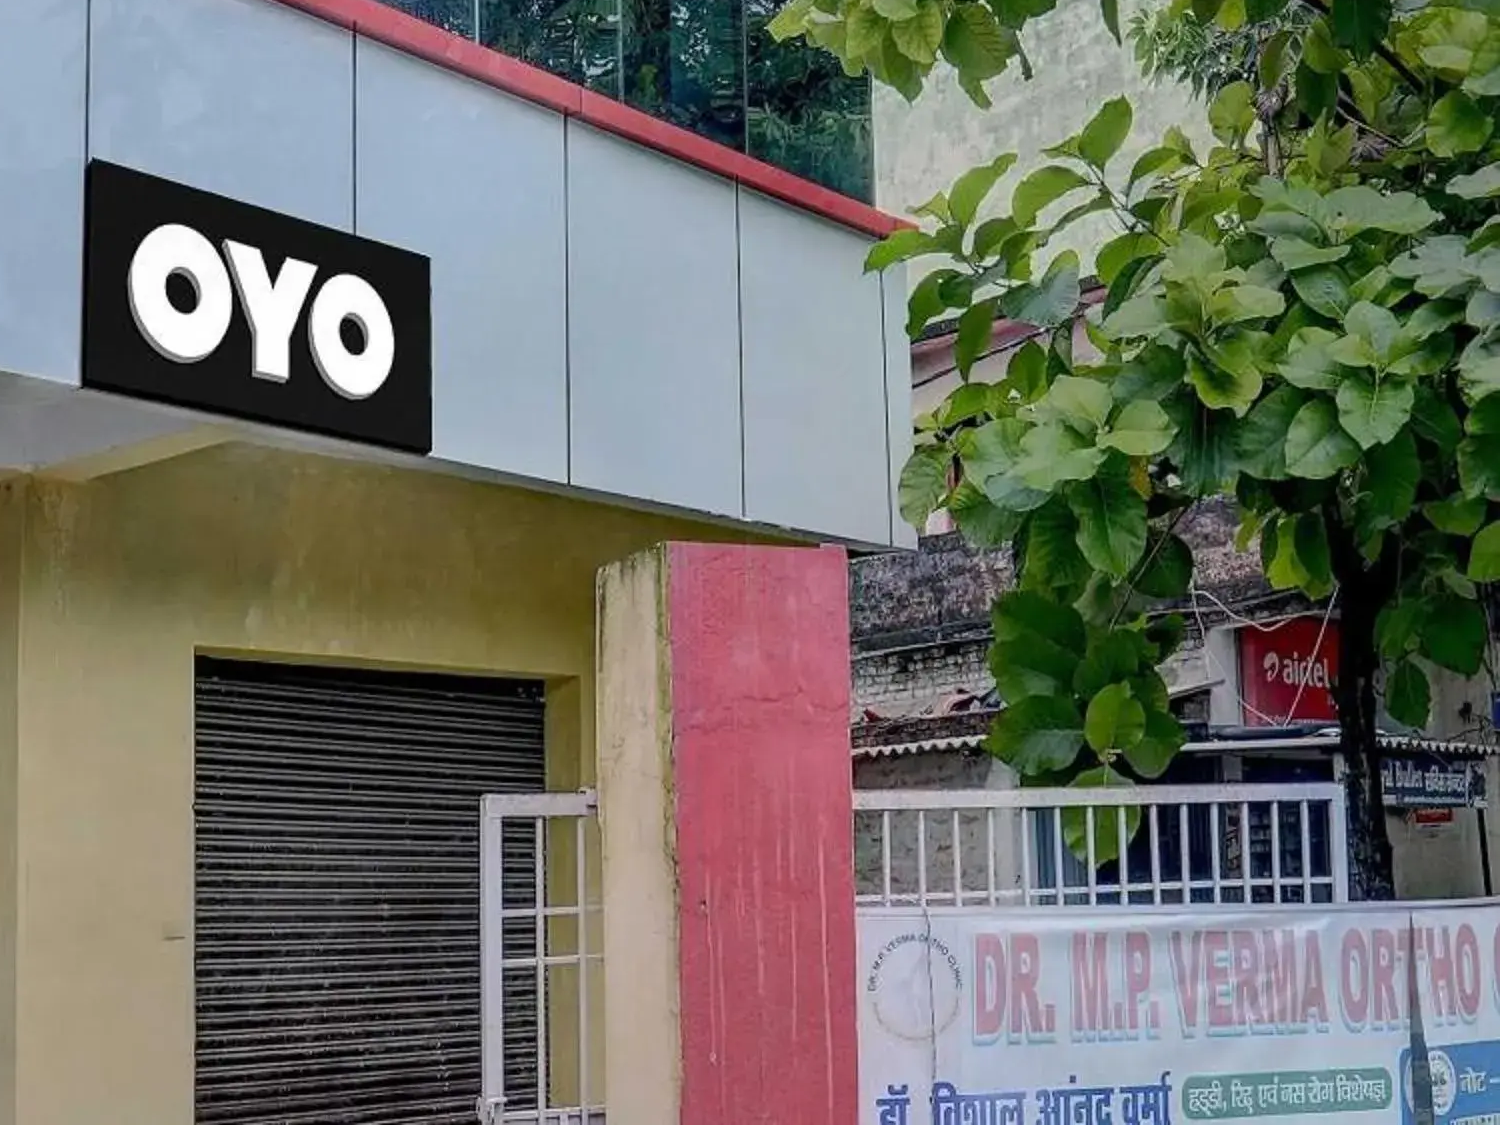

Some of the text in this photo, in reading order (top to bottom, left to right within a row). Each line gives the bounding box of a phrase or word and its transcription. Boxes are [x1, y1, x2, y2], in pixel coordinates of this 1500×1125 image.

[127, 223, 395, 400] OYO
[1283, 651, 1330, 689] airtel
[974, 932, 1057, 1045] DR.
[1071, 930, 1160, 1042] M.P.
[1170, 929, 1329, 1037] VERMA
[1307, 1077, 1334, 1103] रोग
